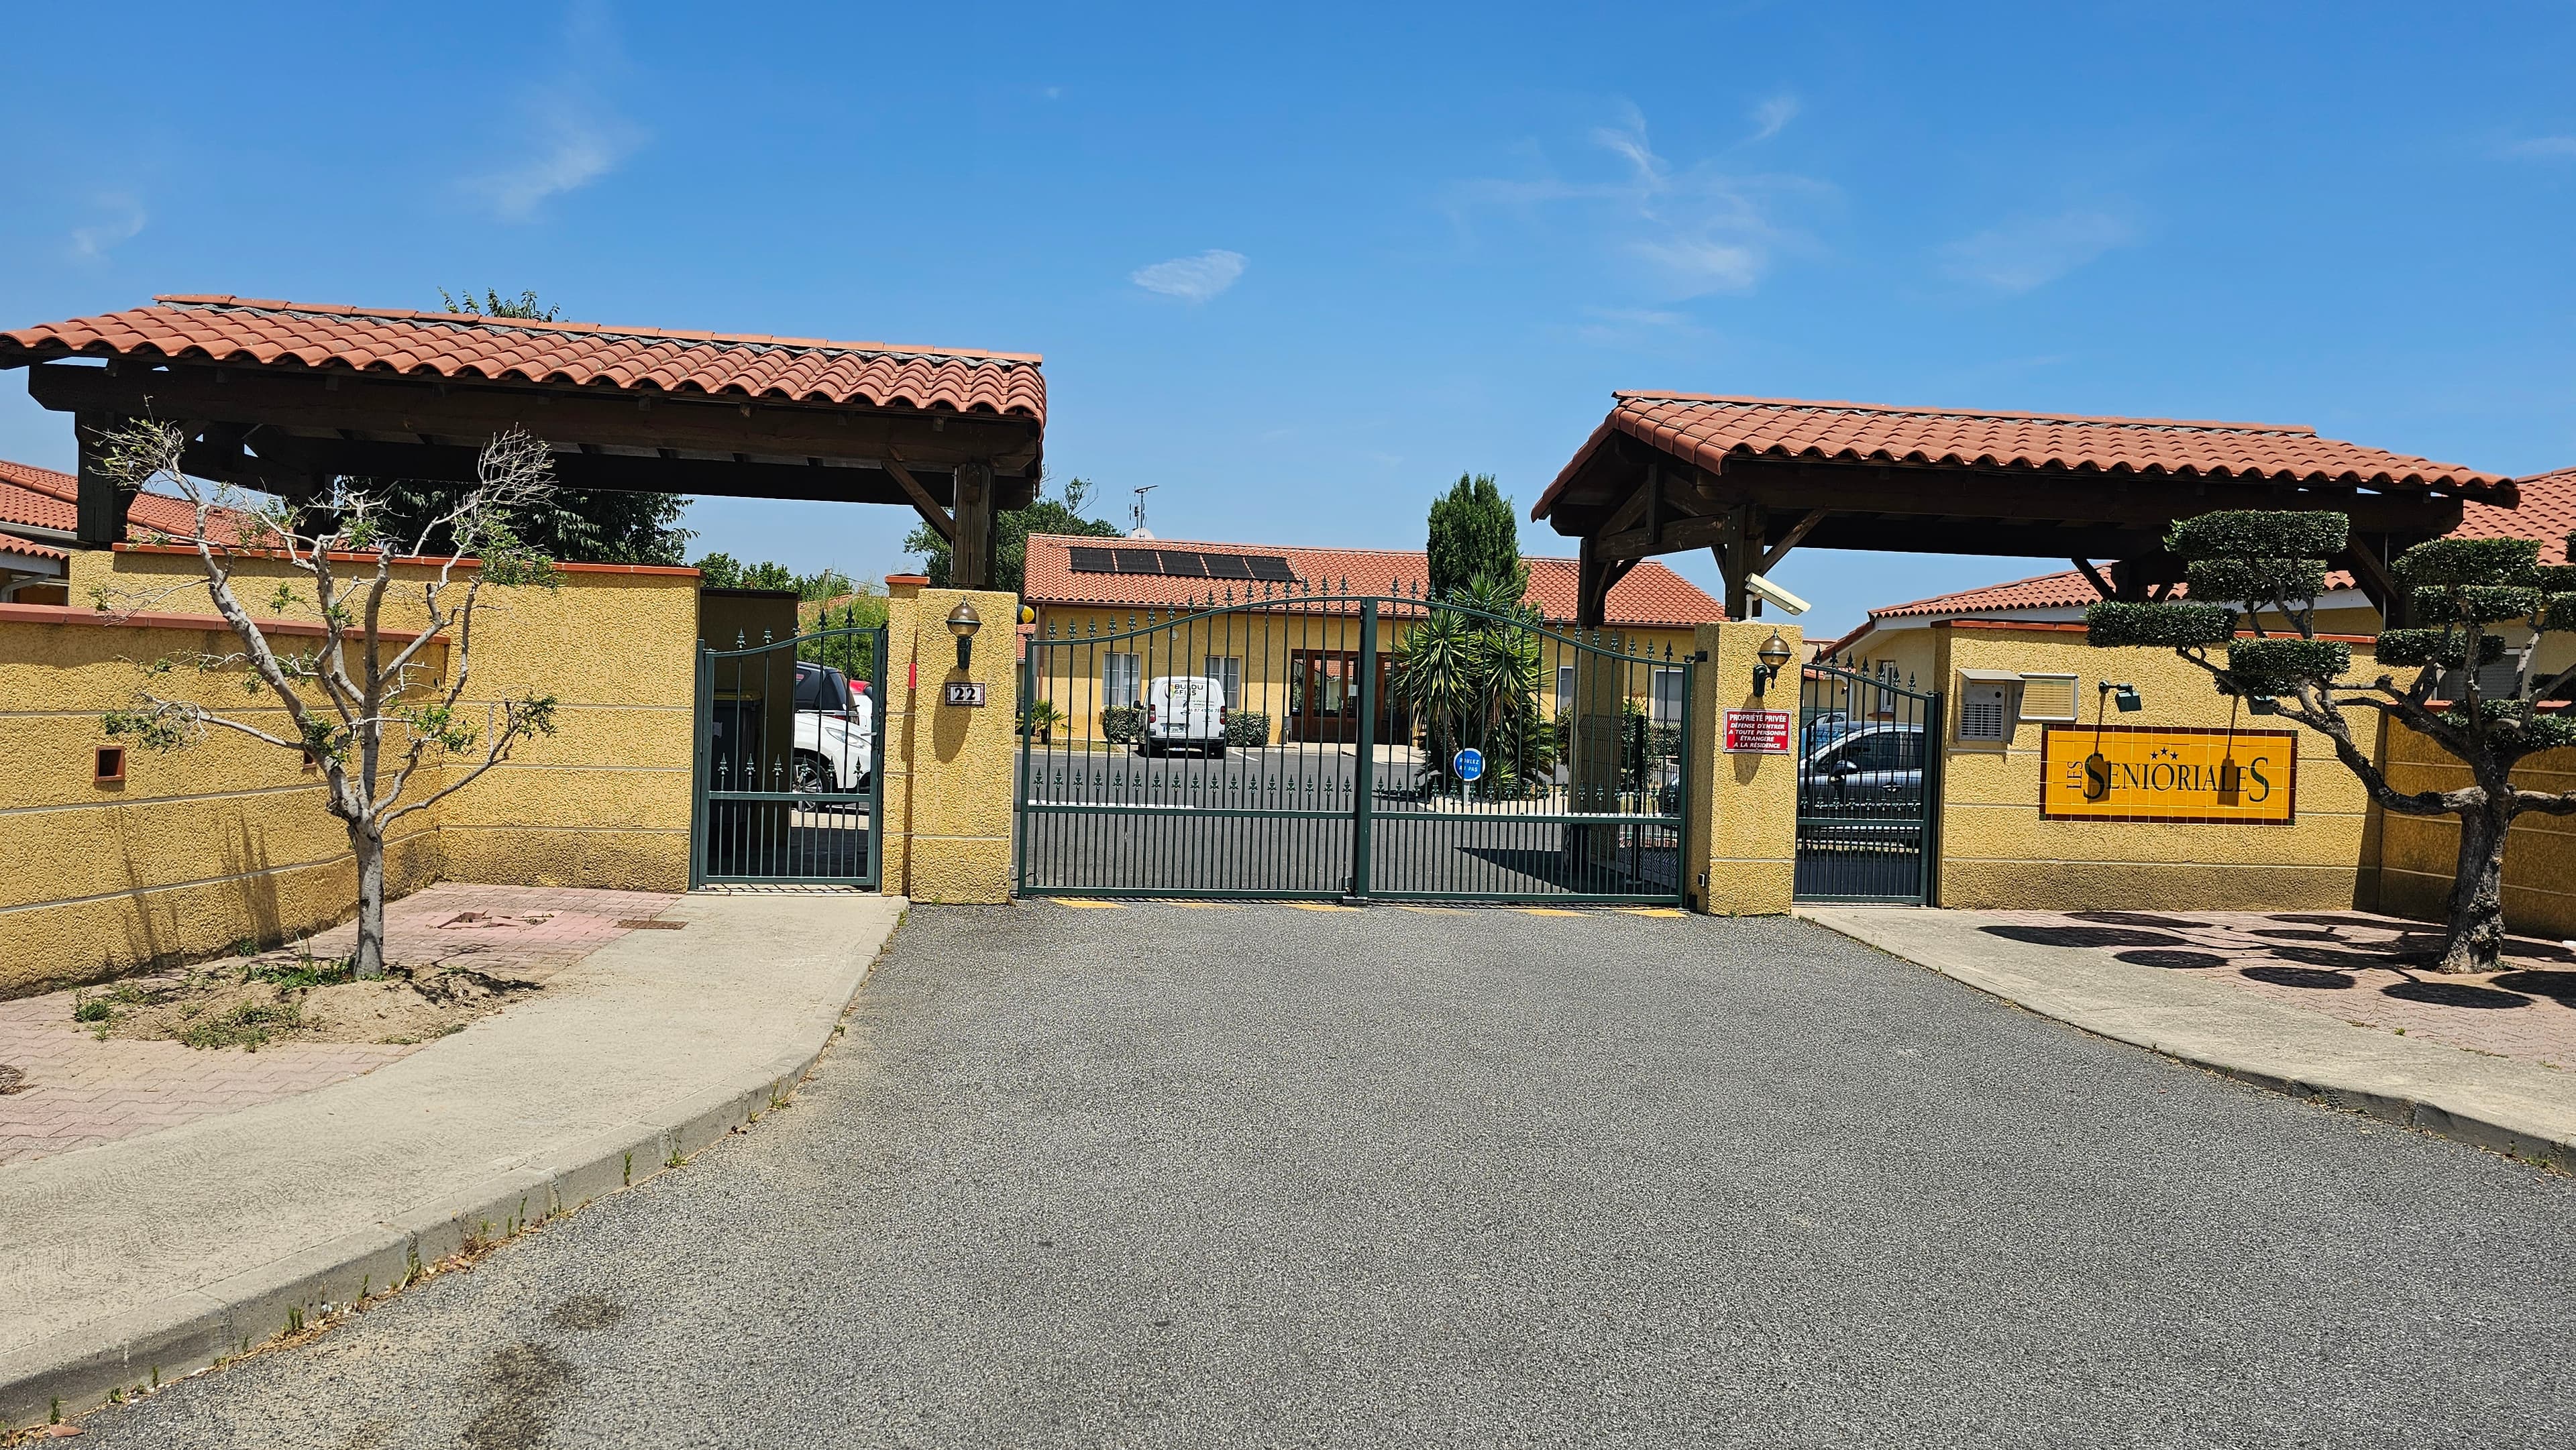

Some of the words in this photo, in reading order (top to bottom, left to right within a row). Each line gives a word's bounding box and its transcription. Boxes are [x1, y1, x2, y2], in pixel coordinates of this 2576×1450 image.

[954, 687, 976, 700] 22
[1729, 713, 1764, 722] PROPRIÉTÉ
[1765, 714, 1787, 722] PRIVÉE
[2066, 761, 2083, 789] LES
[2083, 752, 2269, 802] SENIORIALES
